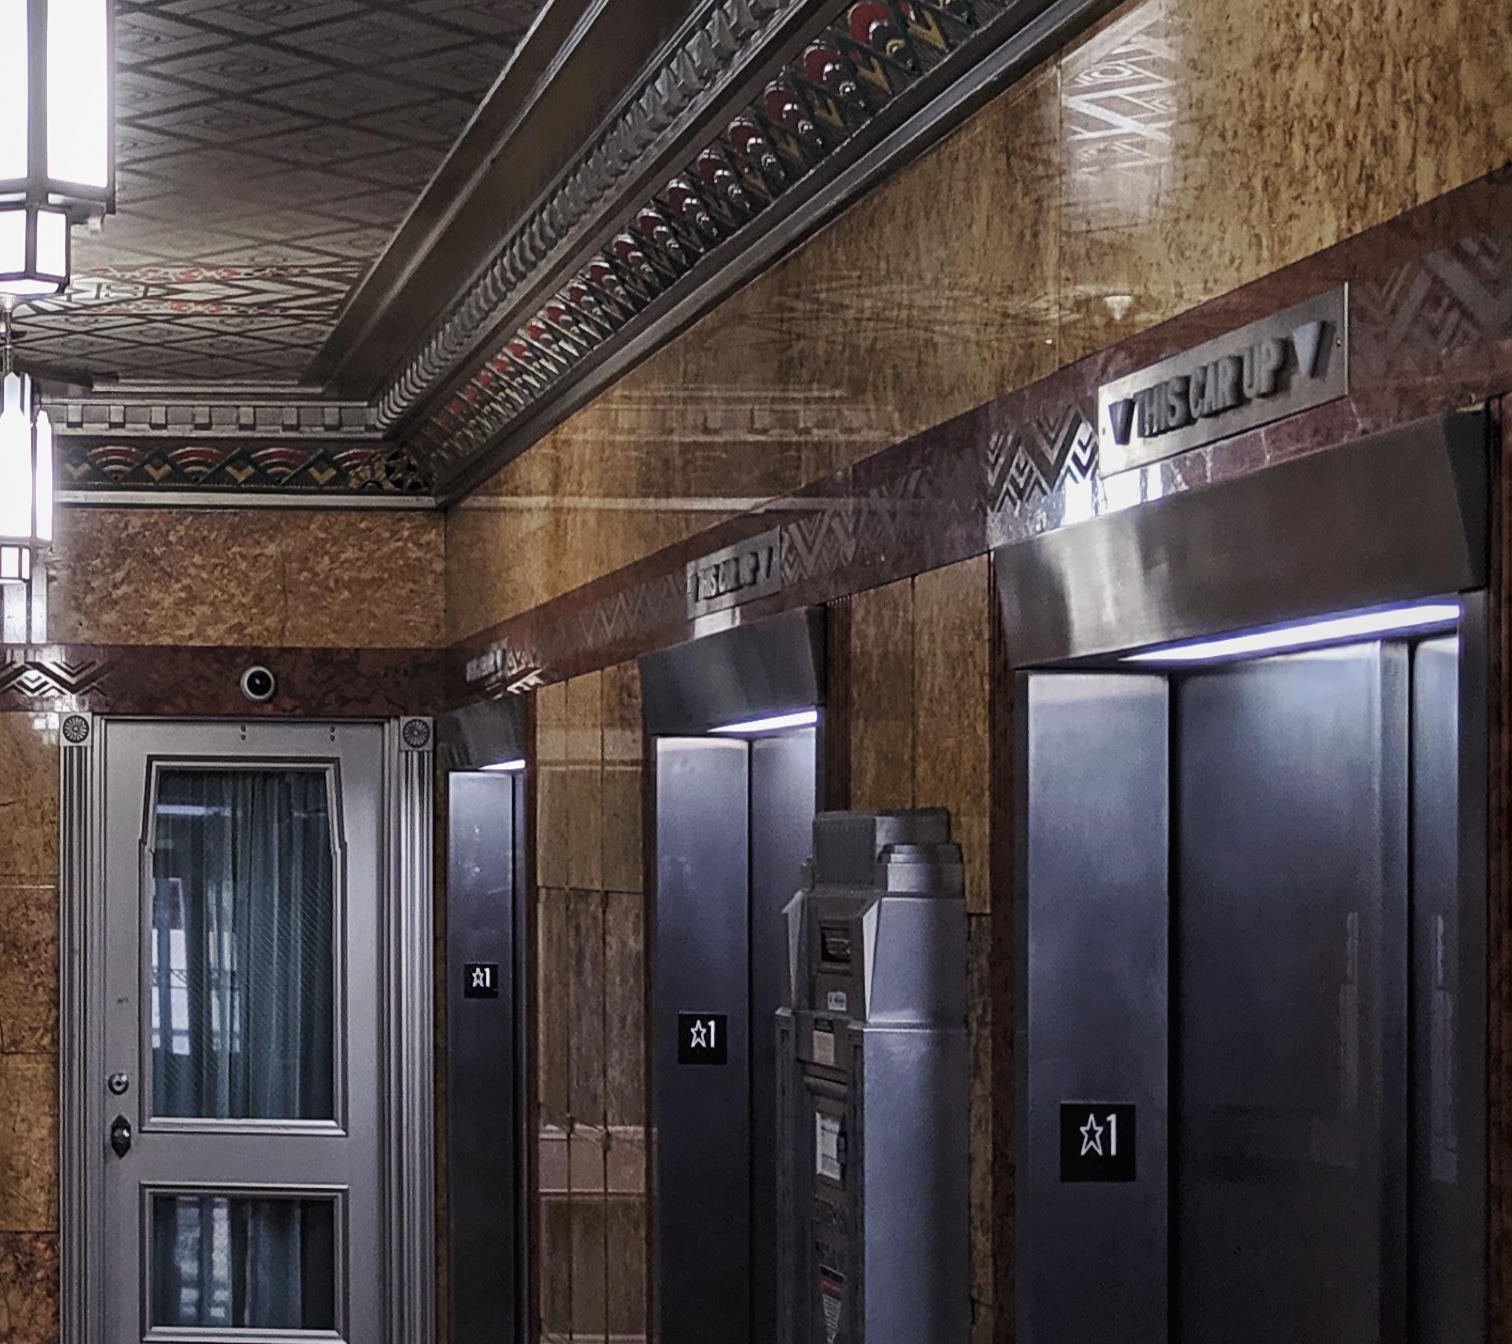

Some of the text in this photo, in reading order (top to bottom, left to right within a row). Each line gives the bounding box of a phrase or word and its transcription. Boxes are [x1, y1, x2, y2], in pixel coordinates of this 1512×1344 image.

[1133, 338, 1285, 438] THIS CAR UP
[1106, 1113, 1117, 1157] 1
